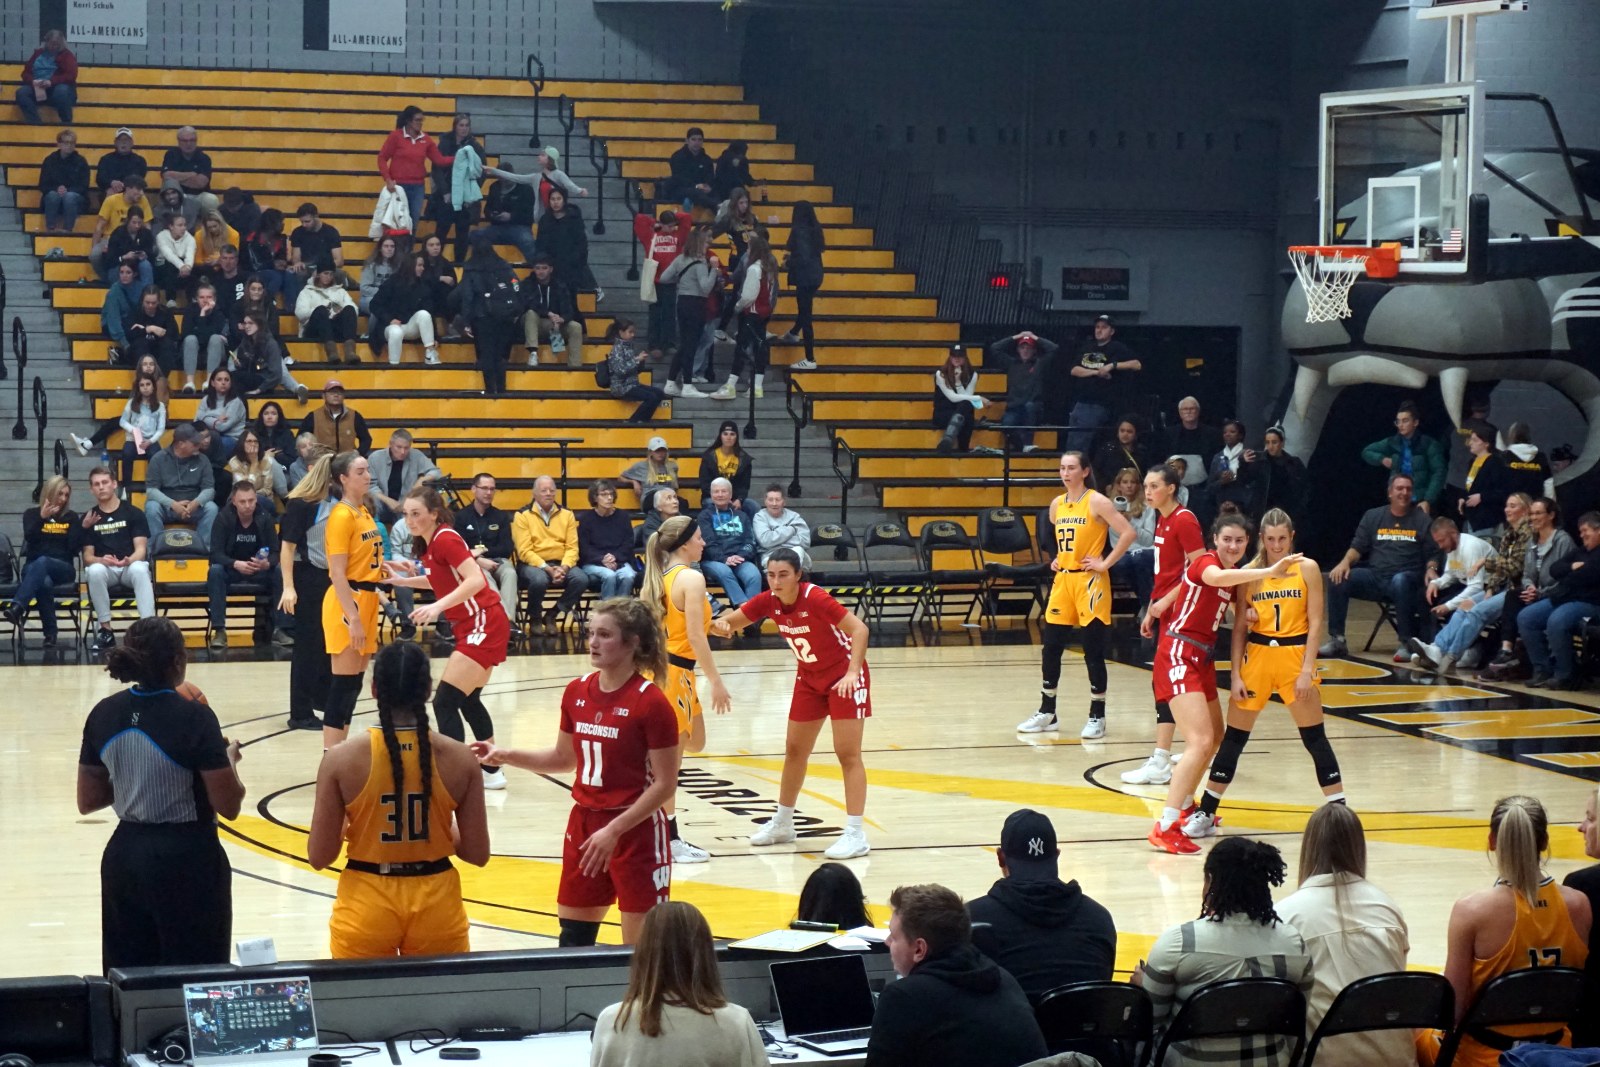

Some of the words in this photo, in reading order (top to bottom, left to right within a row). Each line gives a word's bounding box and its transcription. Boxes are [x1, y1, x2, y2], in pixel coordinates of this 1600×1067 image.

[70, 25, 144, 37] ALL-AMERICANS
[332, 34, 403, 46] ALL-AMERICANS
[1058, 528, 1075, 552] 22
[1252, 589, 1302, 602] MILWAUKEE
[1274, 604, 1280, 632] 1
[786, 637, 818, 663] 12
[576, 721, 619, 739] WISCONSIN
[581, 739, 603, 787] 11
[381, 793, 430, 842] 30
